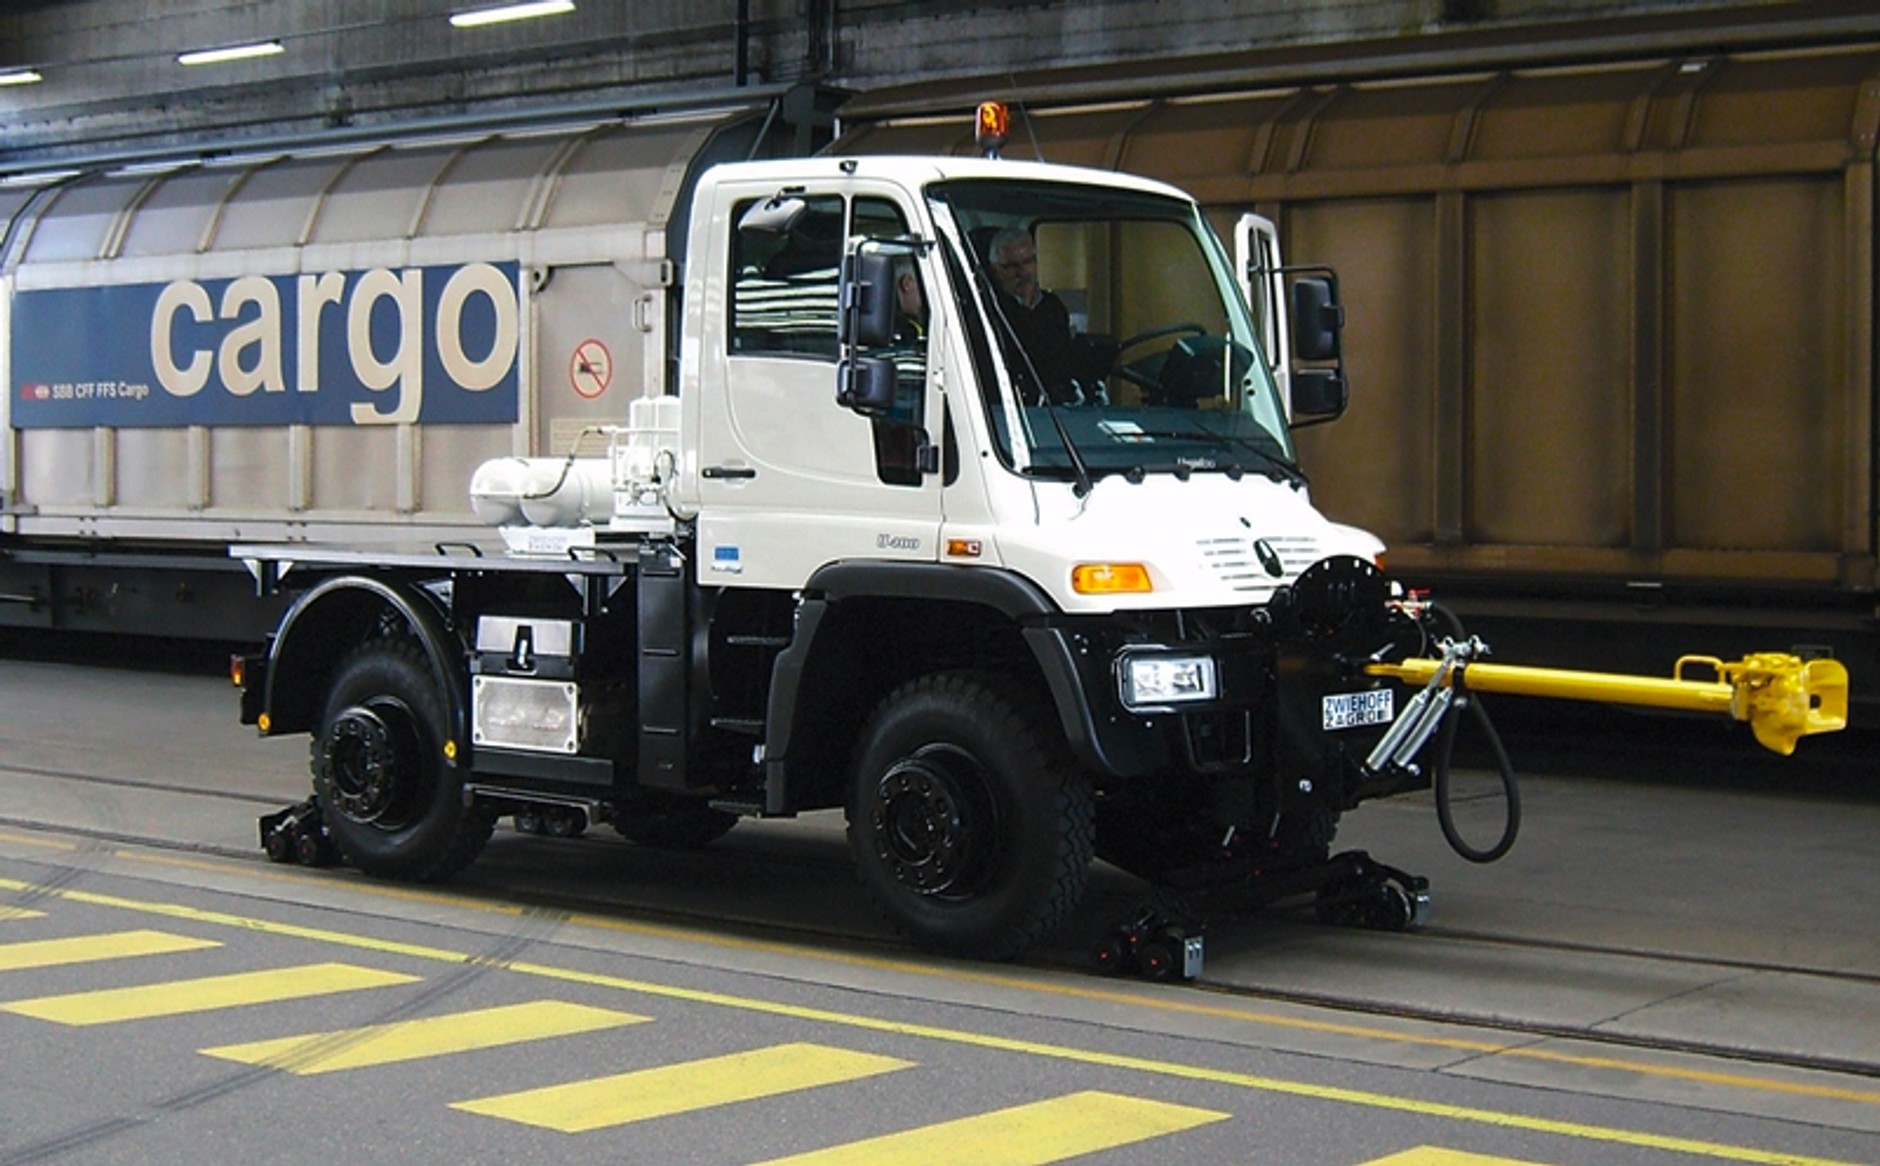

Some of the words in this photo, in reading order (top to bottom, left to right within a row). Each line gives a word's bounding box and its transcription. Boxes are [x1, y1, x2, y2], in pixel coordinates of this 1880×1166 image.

[151, 262, 518, 424] cargo
[52, 384, 74, 399] SBB
[75, 382, 95, 398] CFF
[97, 381, 116, 398] FFS
[118, 381, 150, 400] Cargo
[1325, 690, 1391, 716] ZWIEHOFF
